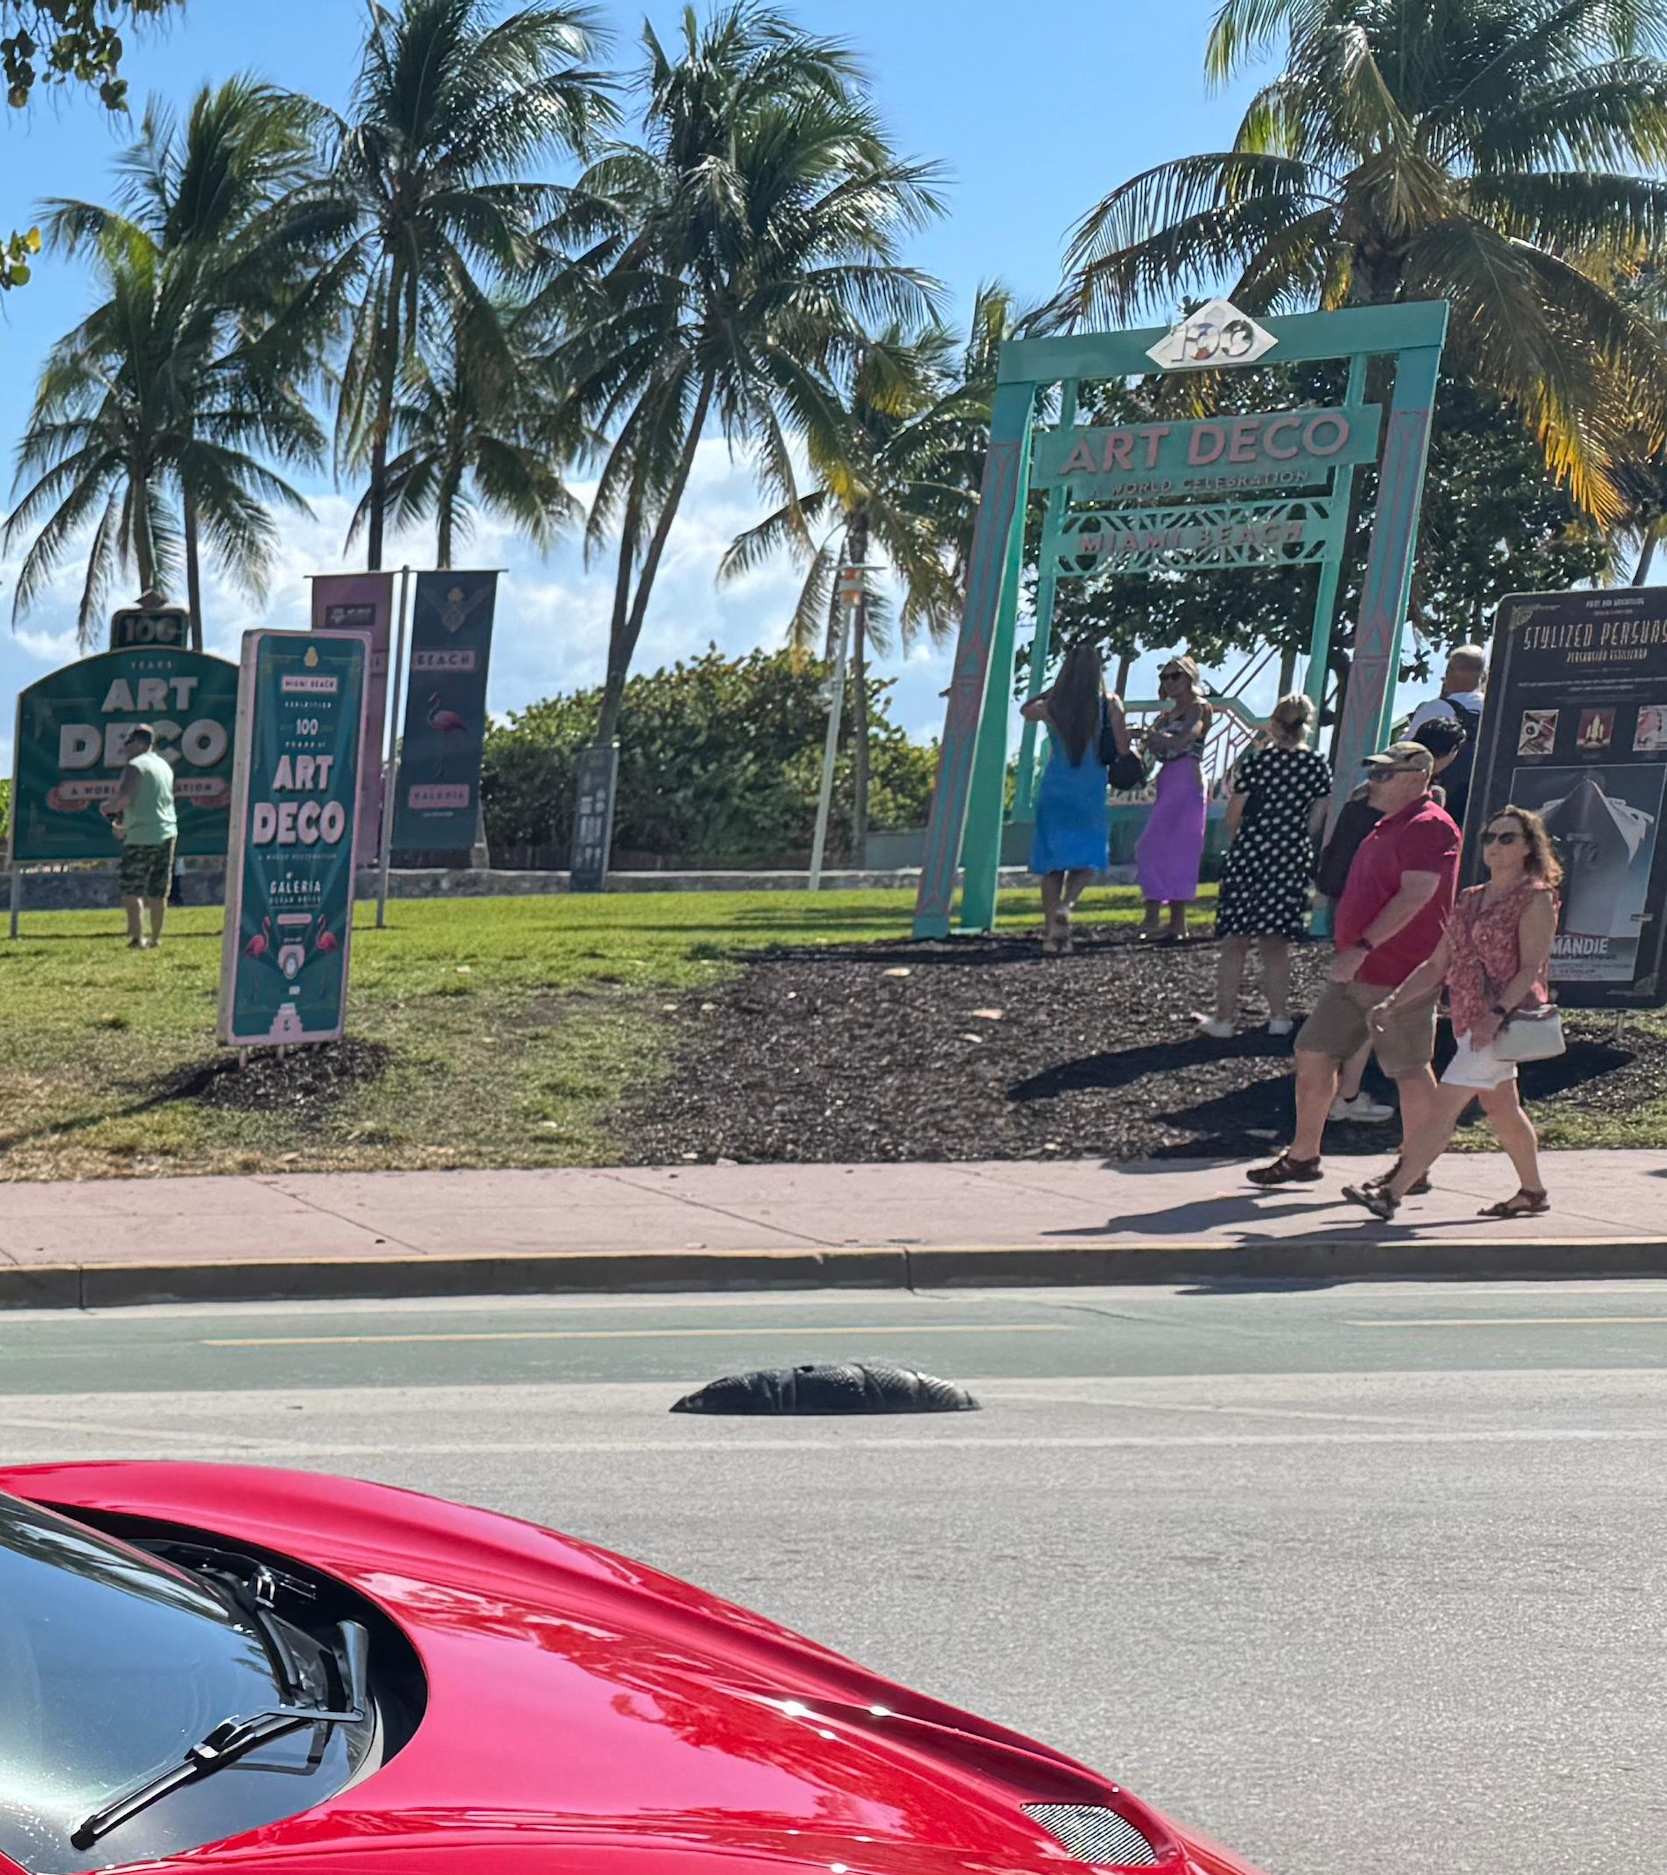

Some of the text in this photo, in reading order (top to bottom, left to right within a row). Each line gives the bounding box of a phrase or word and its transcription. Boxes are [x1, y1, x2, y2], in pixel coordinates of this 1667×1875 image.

[1059, 412, 1351, 476] ART DECO
[1111, 480, 1172, 497] WORLD
[1182, 470, 1309, 491] CELEBRATION
[1079, 522, 1304, 553] MIAMI BEACH
[124, 617, 178, 643] 100
[1523, 623, 1594, 650] STYLIZED
[417, 654, 470, 667] BEACH
[100, 676, 199, 714] ART
[296, 718, 319, 736] 100
[58, 718, 229, 771] DECO
[272, 754, 335, 791] ART
[84, 785, 116, 796] WORL
[251, 800, 346, 845] DECO
[1551, 936, 1609, 955] MANDIE
